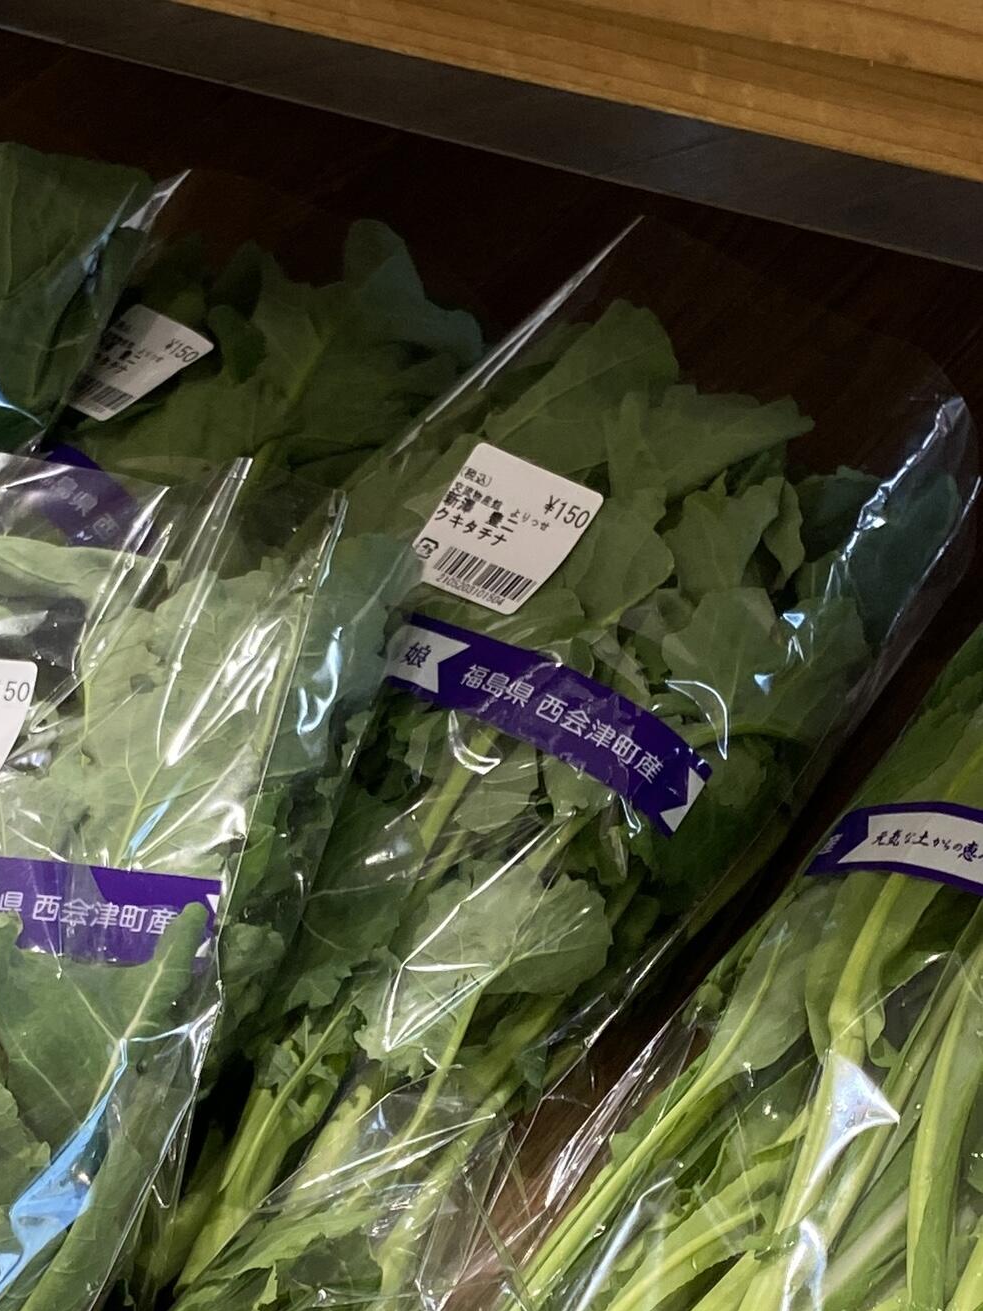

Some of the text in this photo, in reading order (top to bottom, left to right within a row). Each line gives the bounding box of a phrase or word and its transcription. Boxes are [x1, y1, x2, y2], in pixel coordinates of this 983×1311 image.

[166, 337, 200, 363] ¥150
[434, 506, 508, 547] クキタチナ
[544, 494, 591, 530] ¥150
[400, 641, 665, 784] 娘 福島県 西会津町産
[31, 893, 179, 935] 西会津町産
